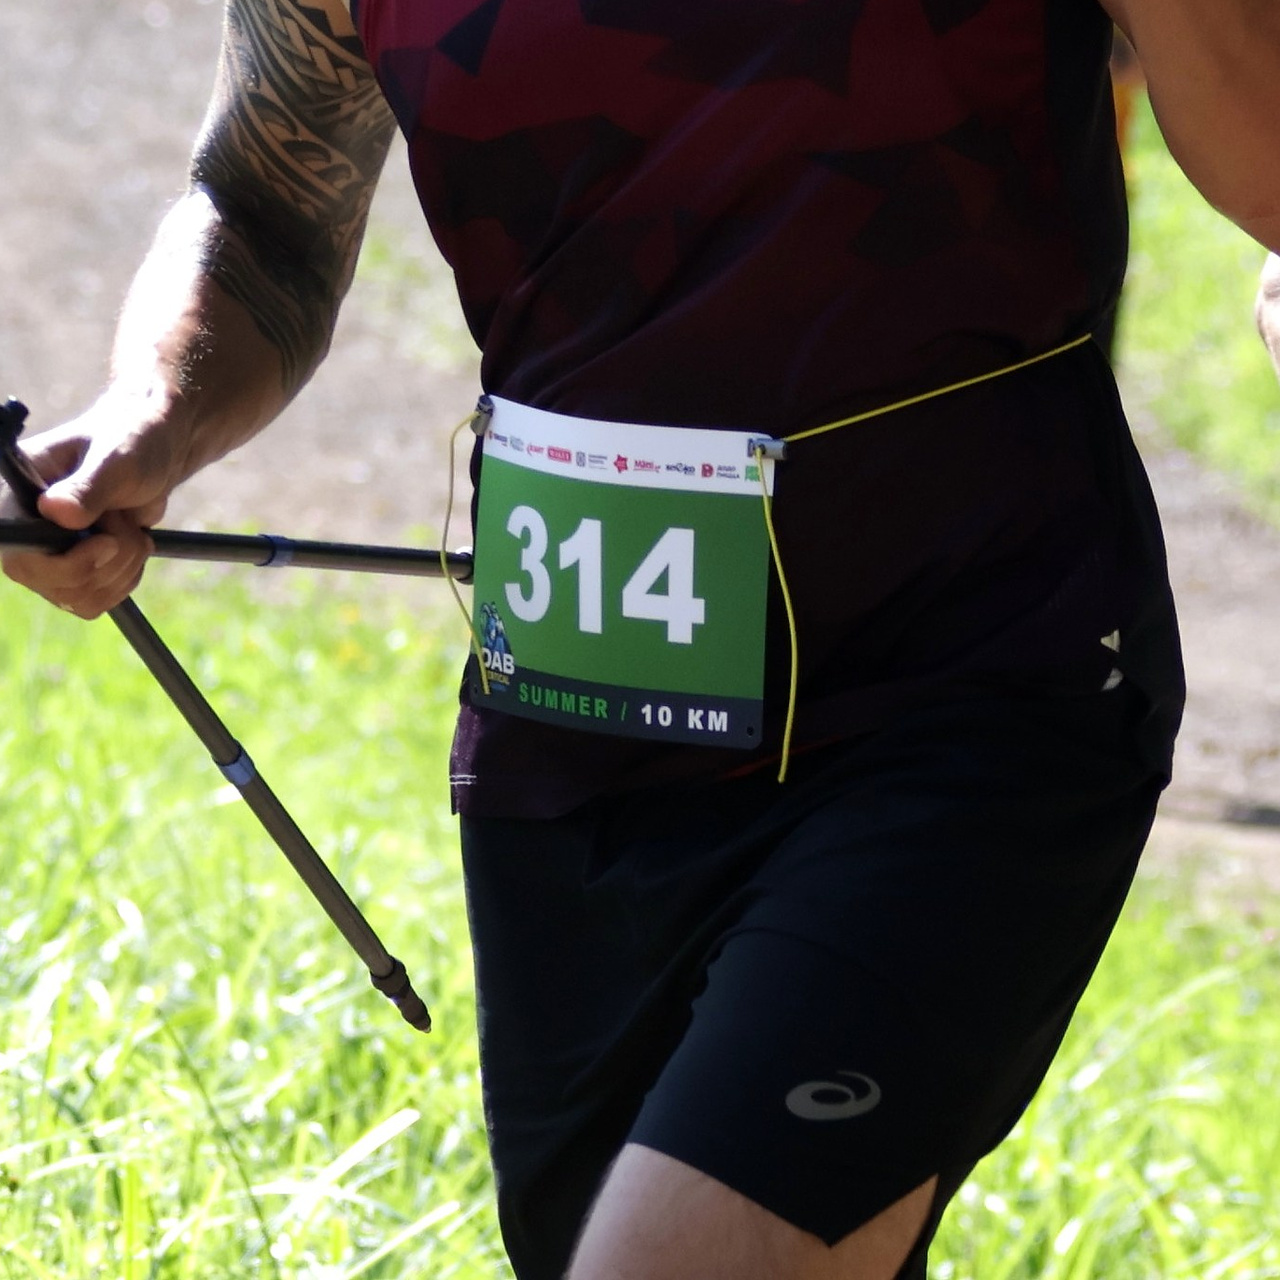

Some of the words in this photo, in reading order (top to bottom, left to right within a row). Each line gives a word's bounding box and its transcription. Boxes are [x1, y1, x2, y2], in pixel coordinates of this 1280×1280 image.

[504, 505, 706, 644] 314
[482, 647, 516, 676] DAB
[519, 683, 608, 720] SUMMER
[641, 704, 673, 727] 10
[688, 708, 728, 733] KM
